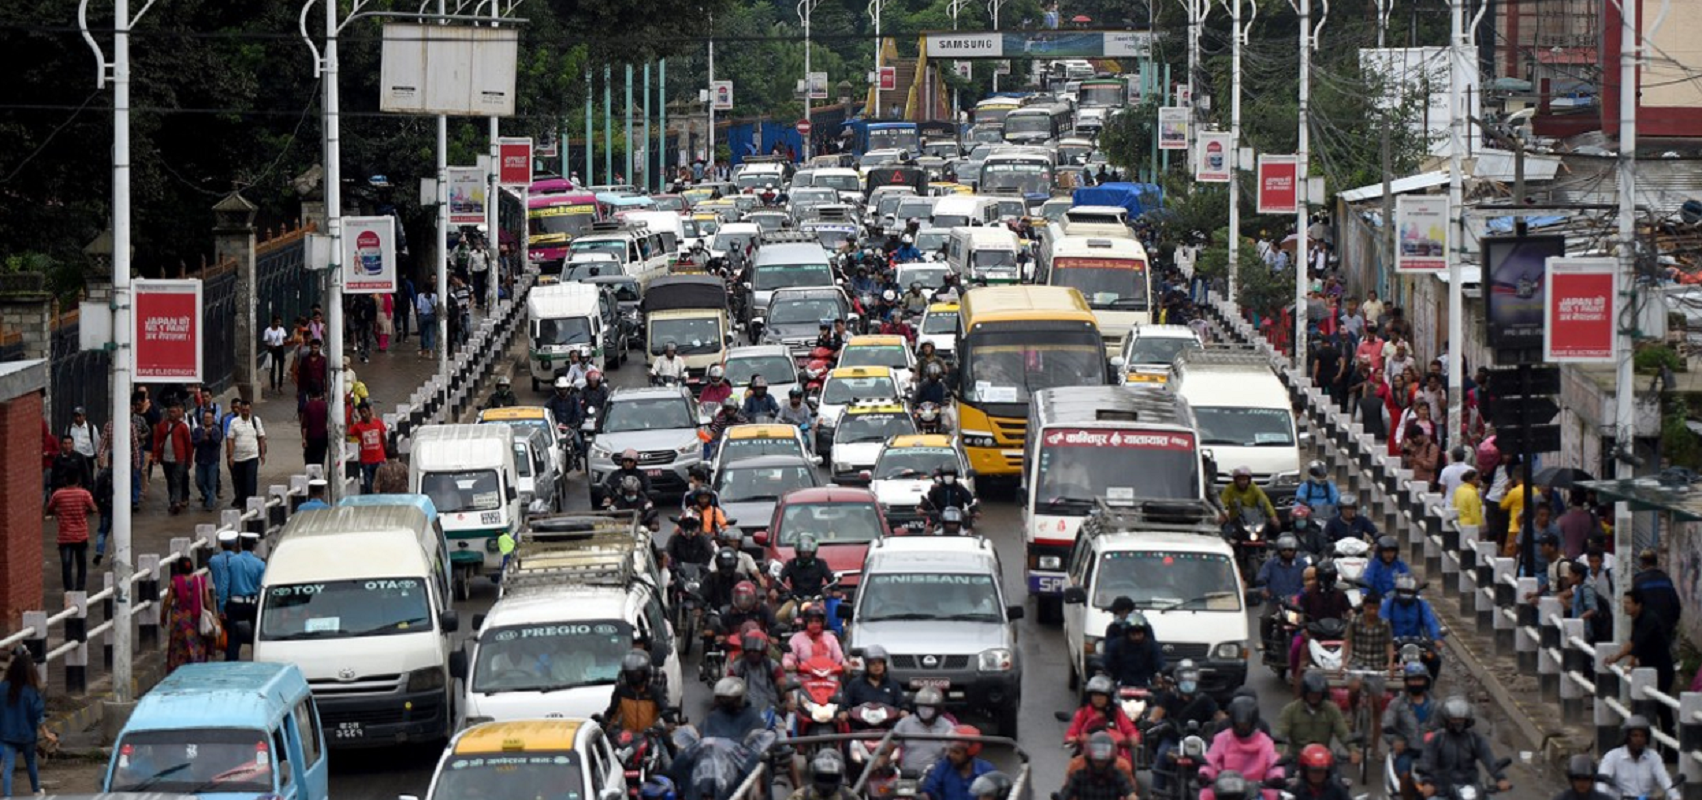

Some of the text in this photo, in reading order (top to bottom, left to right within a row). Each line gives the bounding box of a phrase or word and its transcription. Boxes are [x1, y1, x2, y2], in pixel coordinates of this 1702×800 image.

[939, 40, 992, 49] SAMSUNG
[1559, 298, 1592, 306] JAPAN
[1580, 305, 1604, 313] PAINT
[145, 316, 177, 325] JAPAN
[166, 324, 190, 332] PAINT
[137, 368, 197, 376] SAVE ELECTRICITY
[890, 575, 970, 584] NISSAN
[293, 580, 399, 595] TOY OTA
[521, 625, 591, 638] PREGIO
